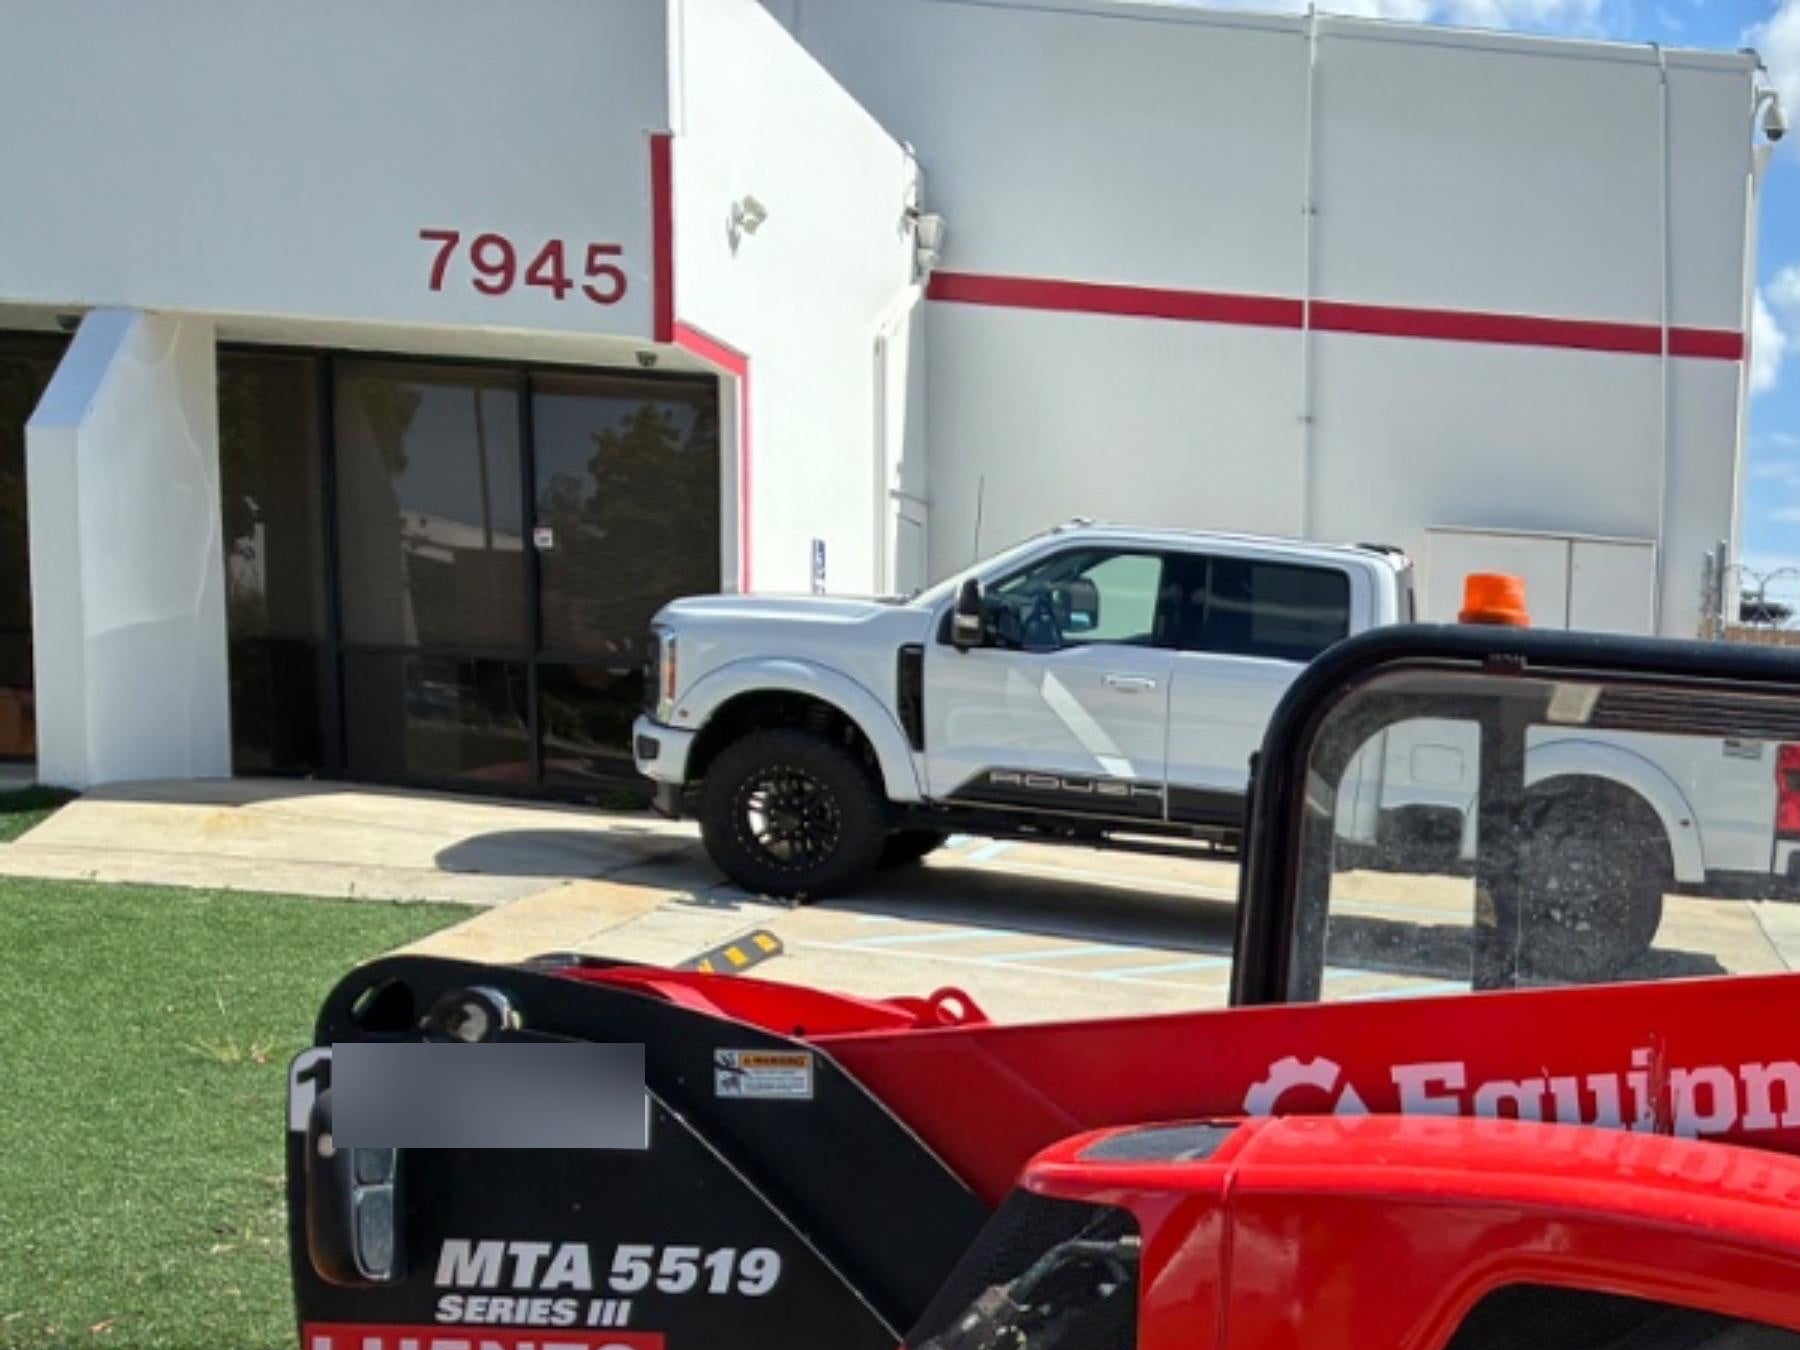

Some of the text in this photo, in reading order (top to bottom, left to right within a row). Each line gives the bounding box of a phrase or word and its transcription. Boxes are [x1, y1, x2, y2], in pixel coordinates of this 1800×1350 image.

[419, 229, 628, 306] 7945
[434, 1238, 781, 1297] MTA 5519
[435, 1295, 632, 1327] SERIES III
